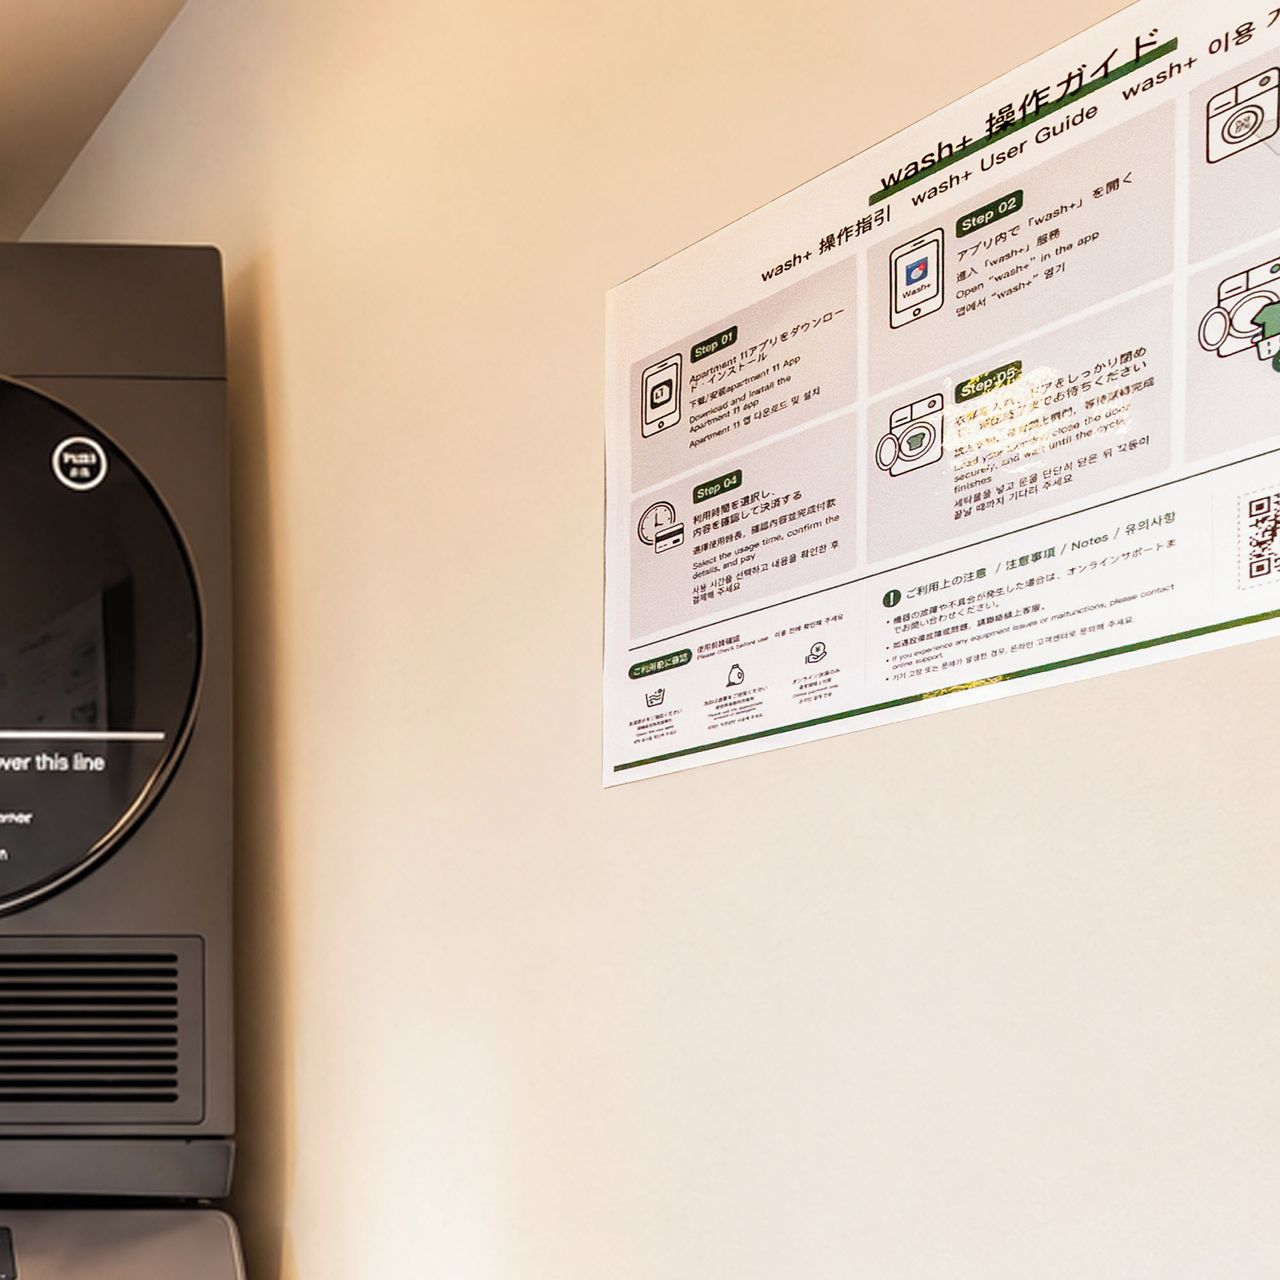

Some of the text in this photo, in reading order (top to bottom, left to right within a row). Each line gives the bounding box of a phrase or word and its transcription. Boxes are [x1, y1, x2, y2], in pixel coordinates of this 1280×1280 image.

[1122, 22, 1256, 101] wash+ 이용
[881, 28, 1159, 190] wash+ 操作ガイド
[912, 106, 1098, 206] wash+ User Guide
[962, 197, 1017, 232] Step 02
[761, 204, 890, 282] wash+ 操作指引
[955, 231, 1099, 301] Open in the app
[694, 332, 733, 358] Step 01
[697, 483, 721, 500] Step
[1071, 534, 1108, 552] Notes
[35, 753, 69, 770] this
[73, 753, 105, 771] line
